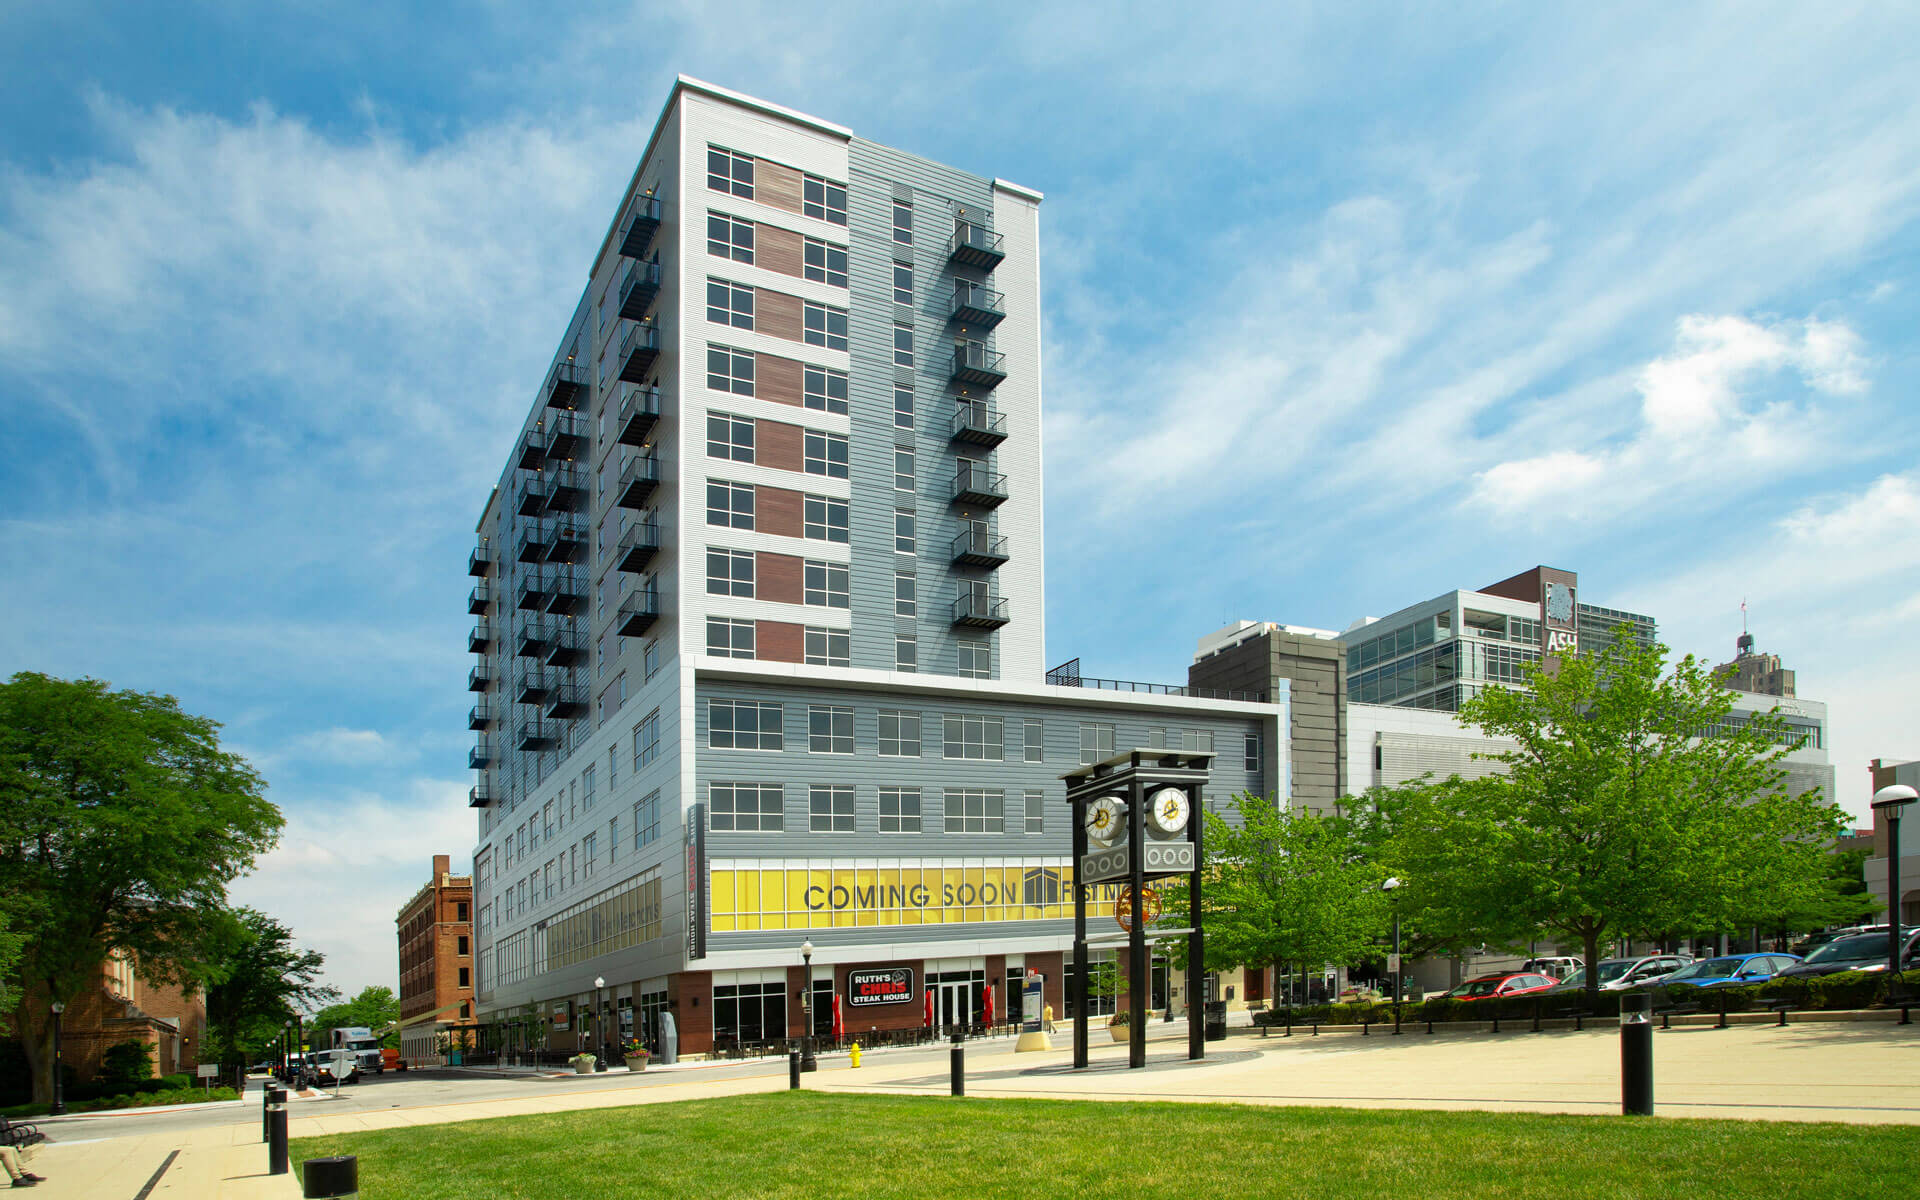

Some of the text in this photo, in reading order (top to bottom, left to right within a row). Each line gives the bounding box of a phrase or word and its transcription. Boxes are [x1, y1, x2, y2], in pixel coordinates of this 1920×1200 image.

[1548, 631, 1577, 654] ASH
[688, 846, 696, 892] CHRIS
[804, 884, 930, 910] COMING
[943, 882, 1016, 907] SOON
[855, 974, 891, 984] RUTH'S
[853, 993, 910, 1003] STEAK HOUSE
[861, 982, 906, 996] CHRIS
